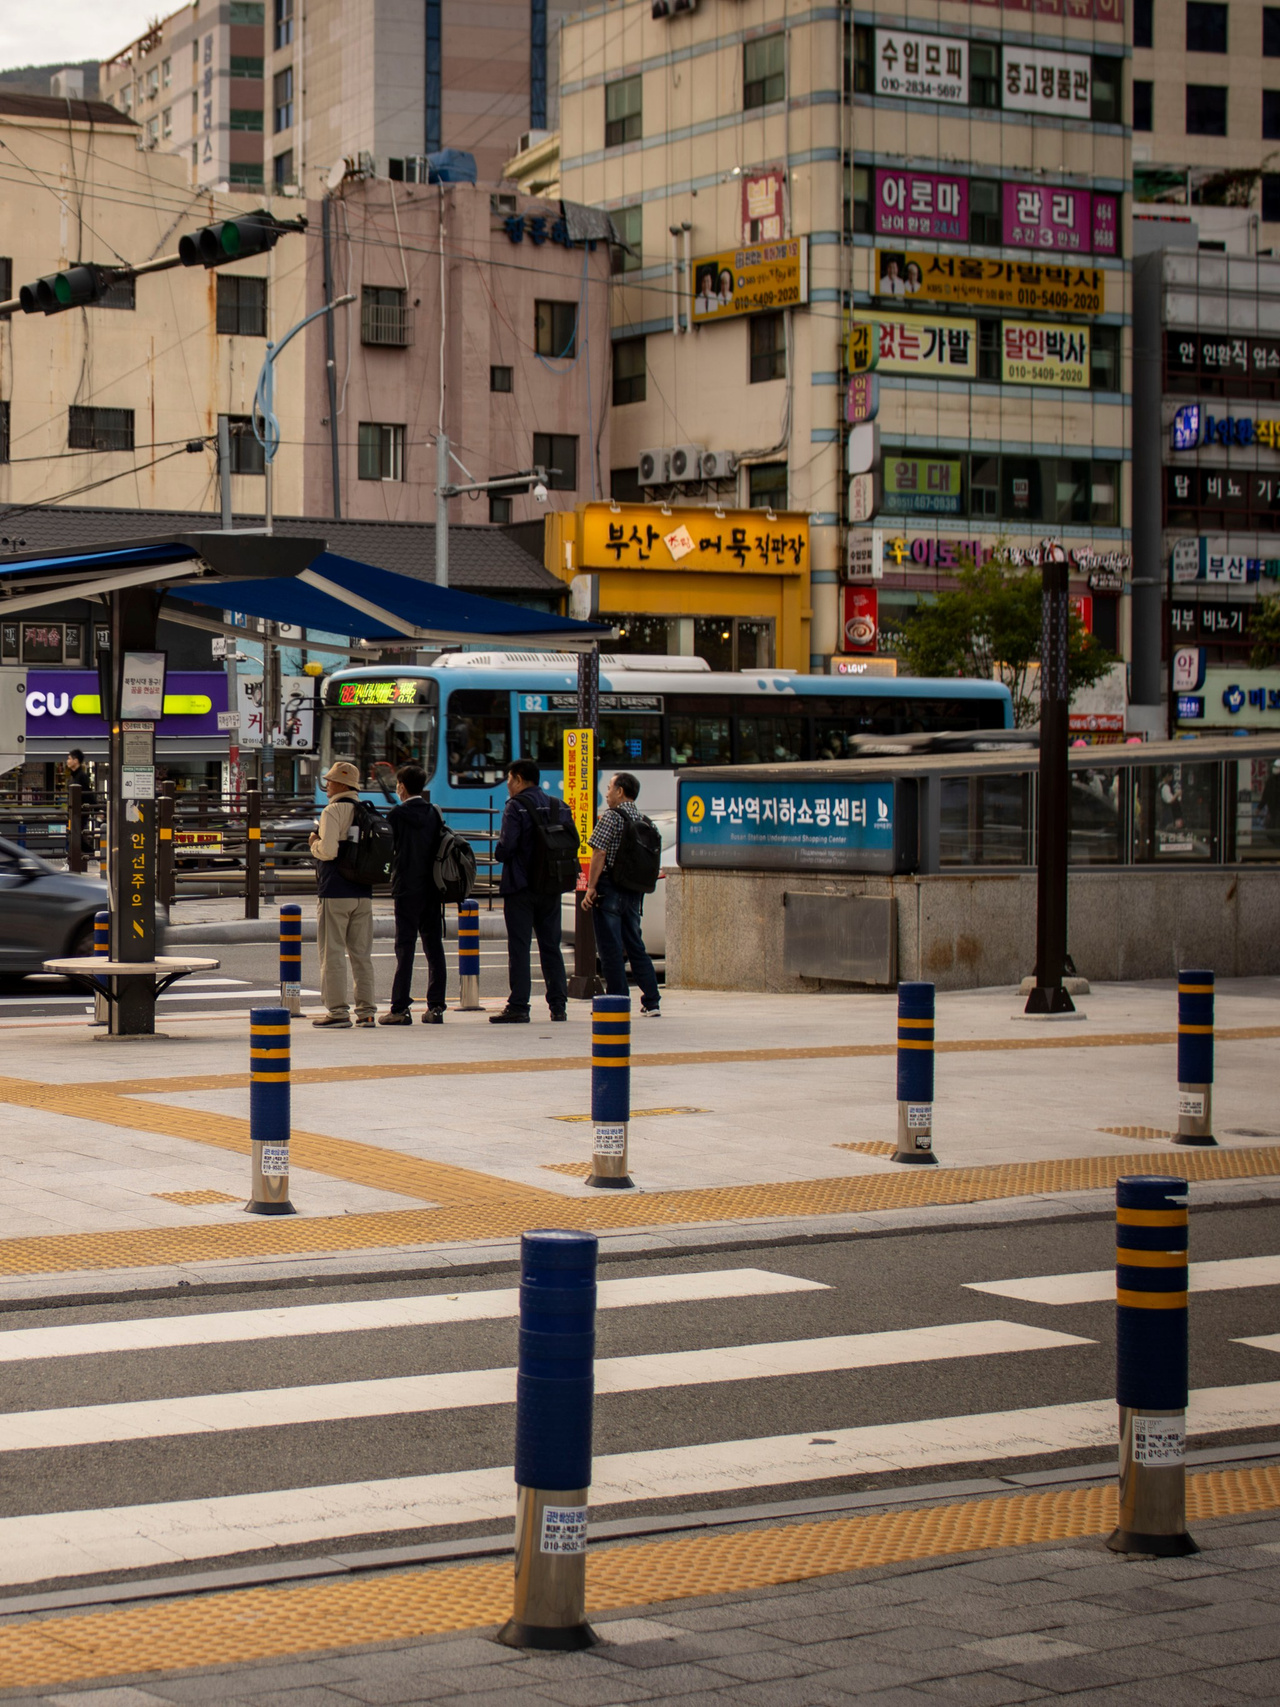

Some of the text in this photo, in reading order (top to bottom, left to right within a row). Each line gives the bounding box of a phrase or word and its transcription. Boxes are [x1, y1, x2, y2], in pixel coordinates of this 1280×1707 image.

[881, 38, 962, 80] 수입모피
[1006, 63, 1089, 102] 중고명품관
[881, 177, 961, 216] 아로마
[1016, 190, 1075, 228] 관리
[1039, 229, 1053, 246] 3
[927, 256, 1101, 290] 서울가발박사
[1017, 288, 1100, 310] 010-5409-2020
[853, 327, 869, 370] 가발
[923, 327, 970, 366] 가발
[1008, 366, 1083, 383] 010-5409-2020
[894, 462, 951, 492] 임대
[606, 523, 660, 561] 부산
[699, 528, 752, 567] 어묵
[754, 532, 805, 566] 직판장
[1209, 556, 1244, 579] 부산
[1177, 655, 1195, 679] 약
[25, 690, 70, 717] CU
[341, 685, 355, 703] 82
[524, 695, 543, 711] 82
[691, 797, 867, 827] 2 부산역지하쇼핑센터
[802, 836, 828, 845] Shopping
[828, 836, 847, 844] Center
